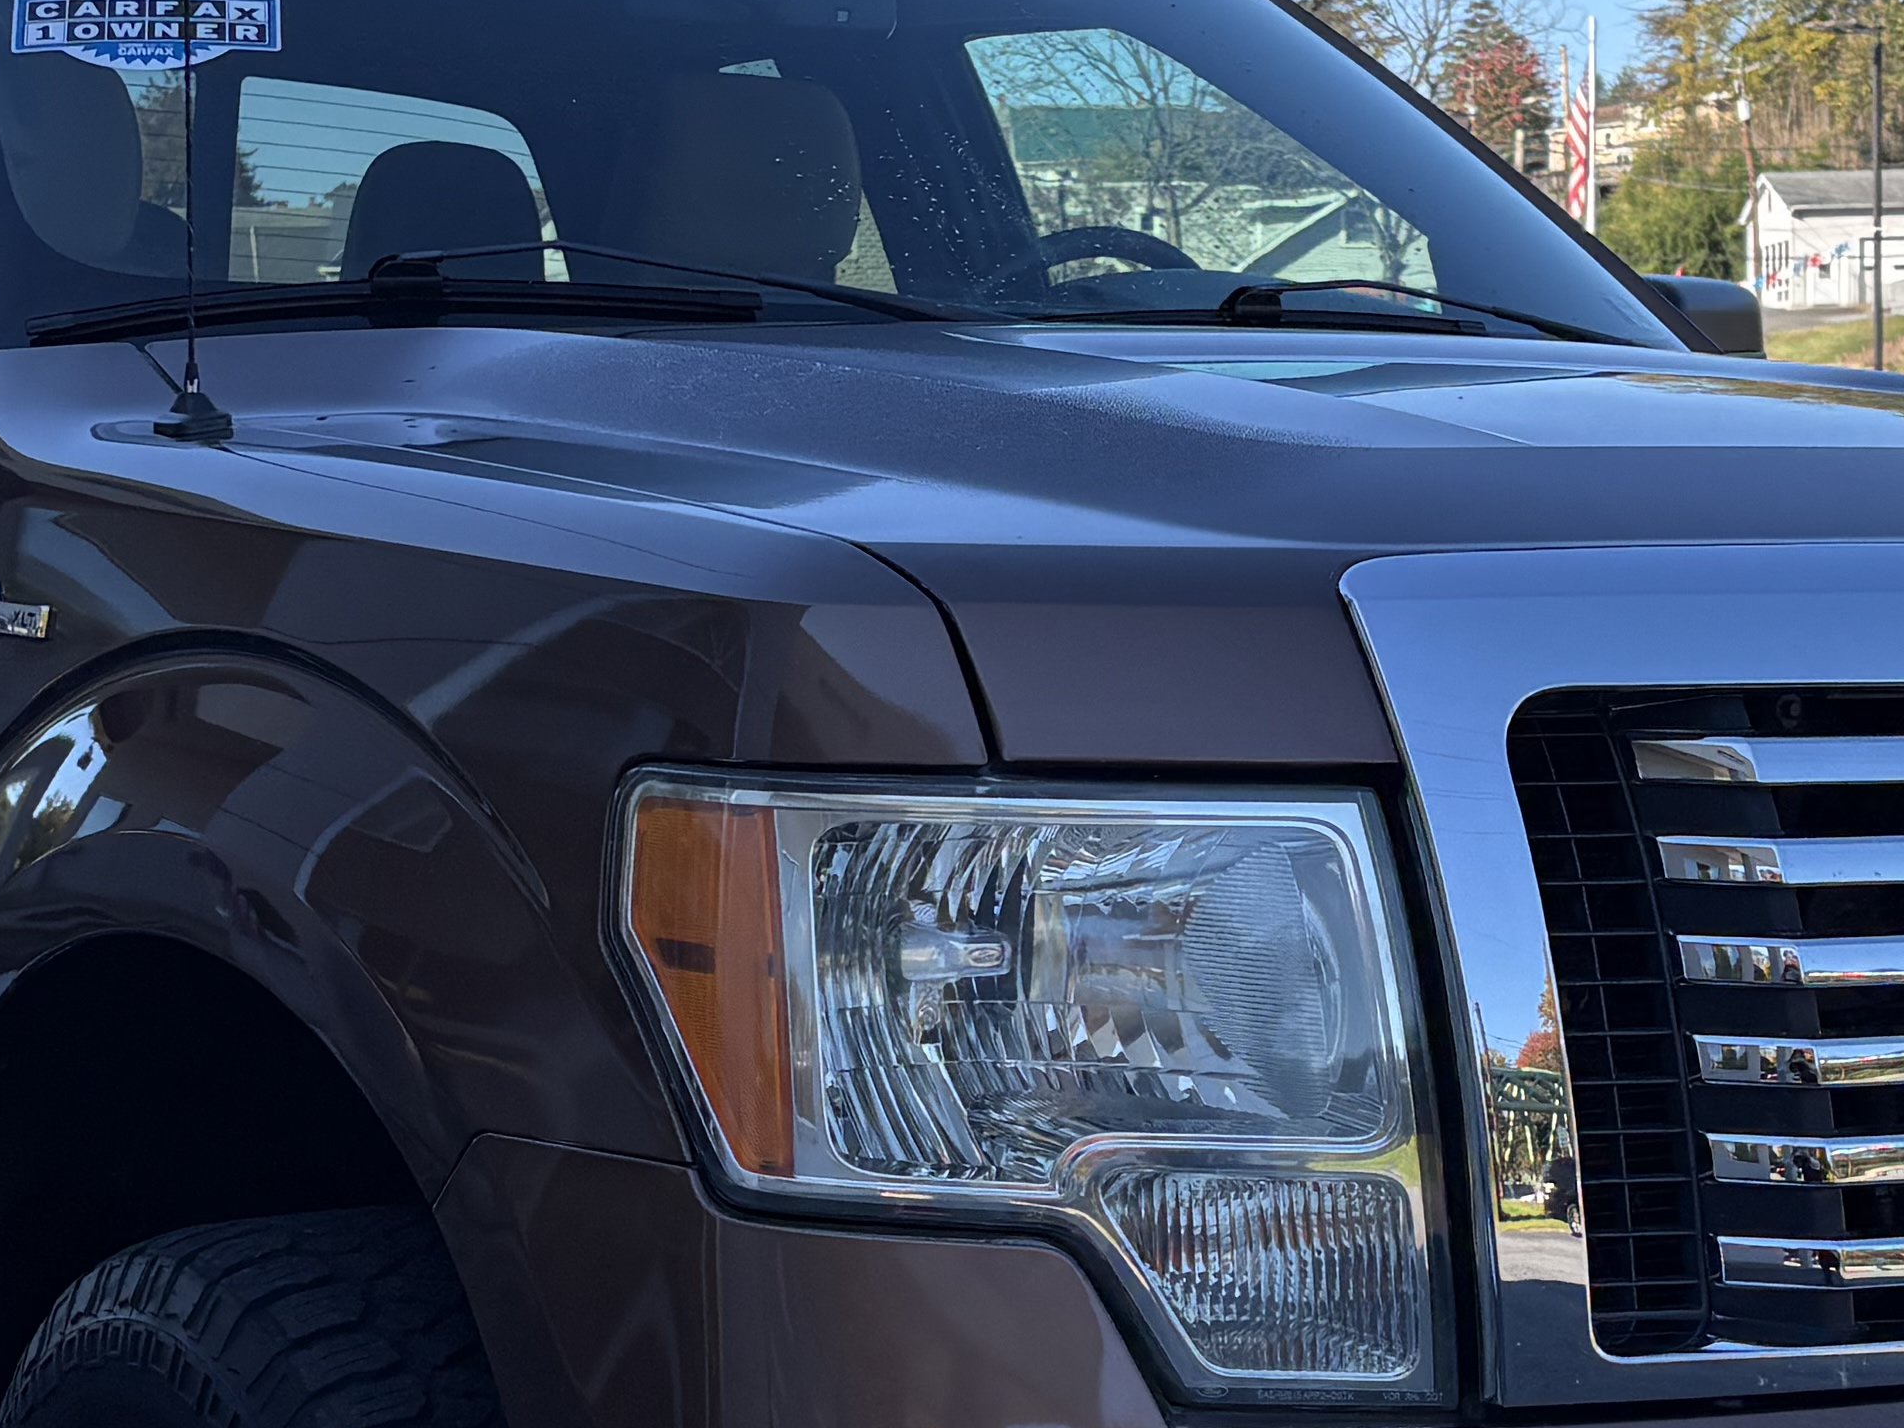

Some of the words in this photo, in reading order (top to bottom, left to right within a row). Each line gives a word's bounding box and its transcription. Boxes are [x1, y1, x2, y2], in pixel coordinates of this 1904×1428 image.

[35, 0, 261, 21] CARFAX
[36, 25, 56, 41] 1
[73, 22, 259, 41] OWNER
[117, 46, 174, 57] CARFAX
